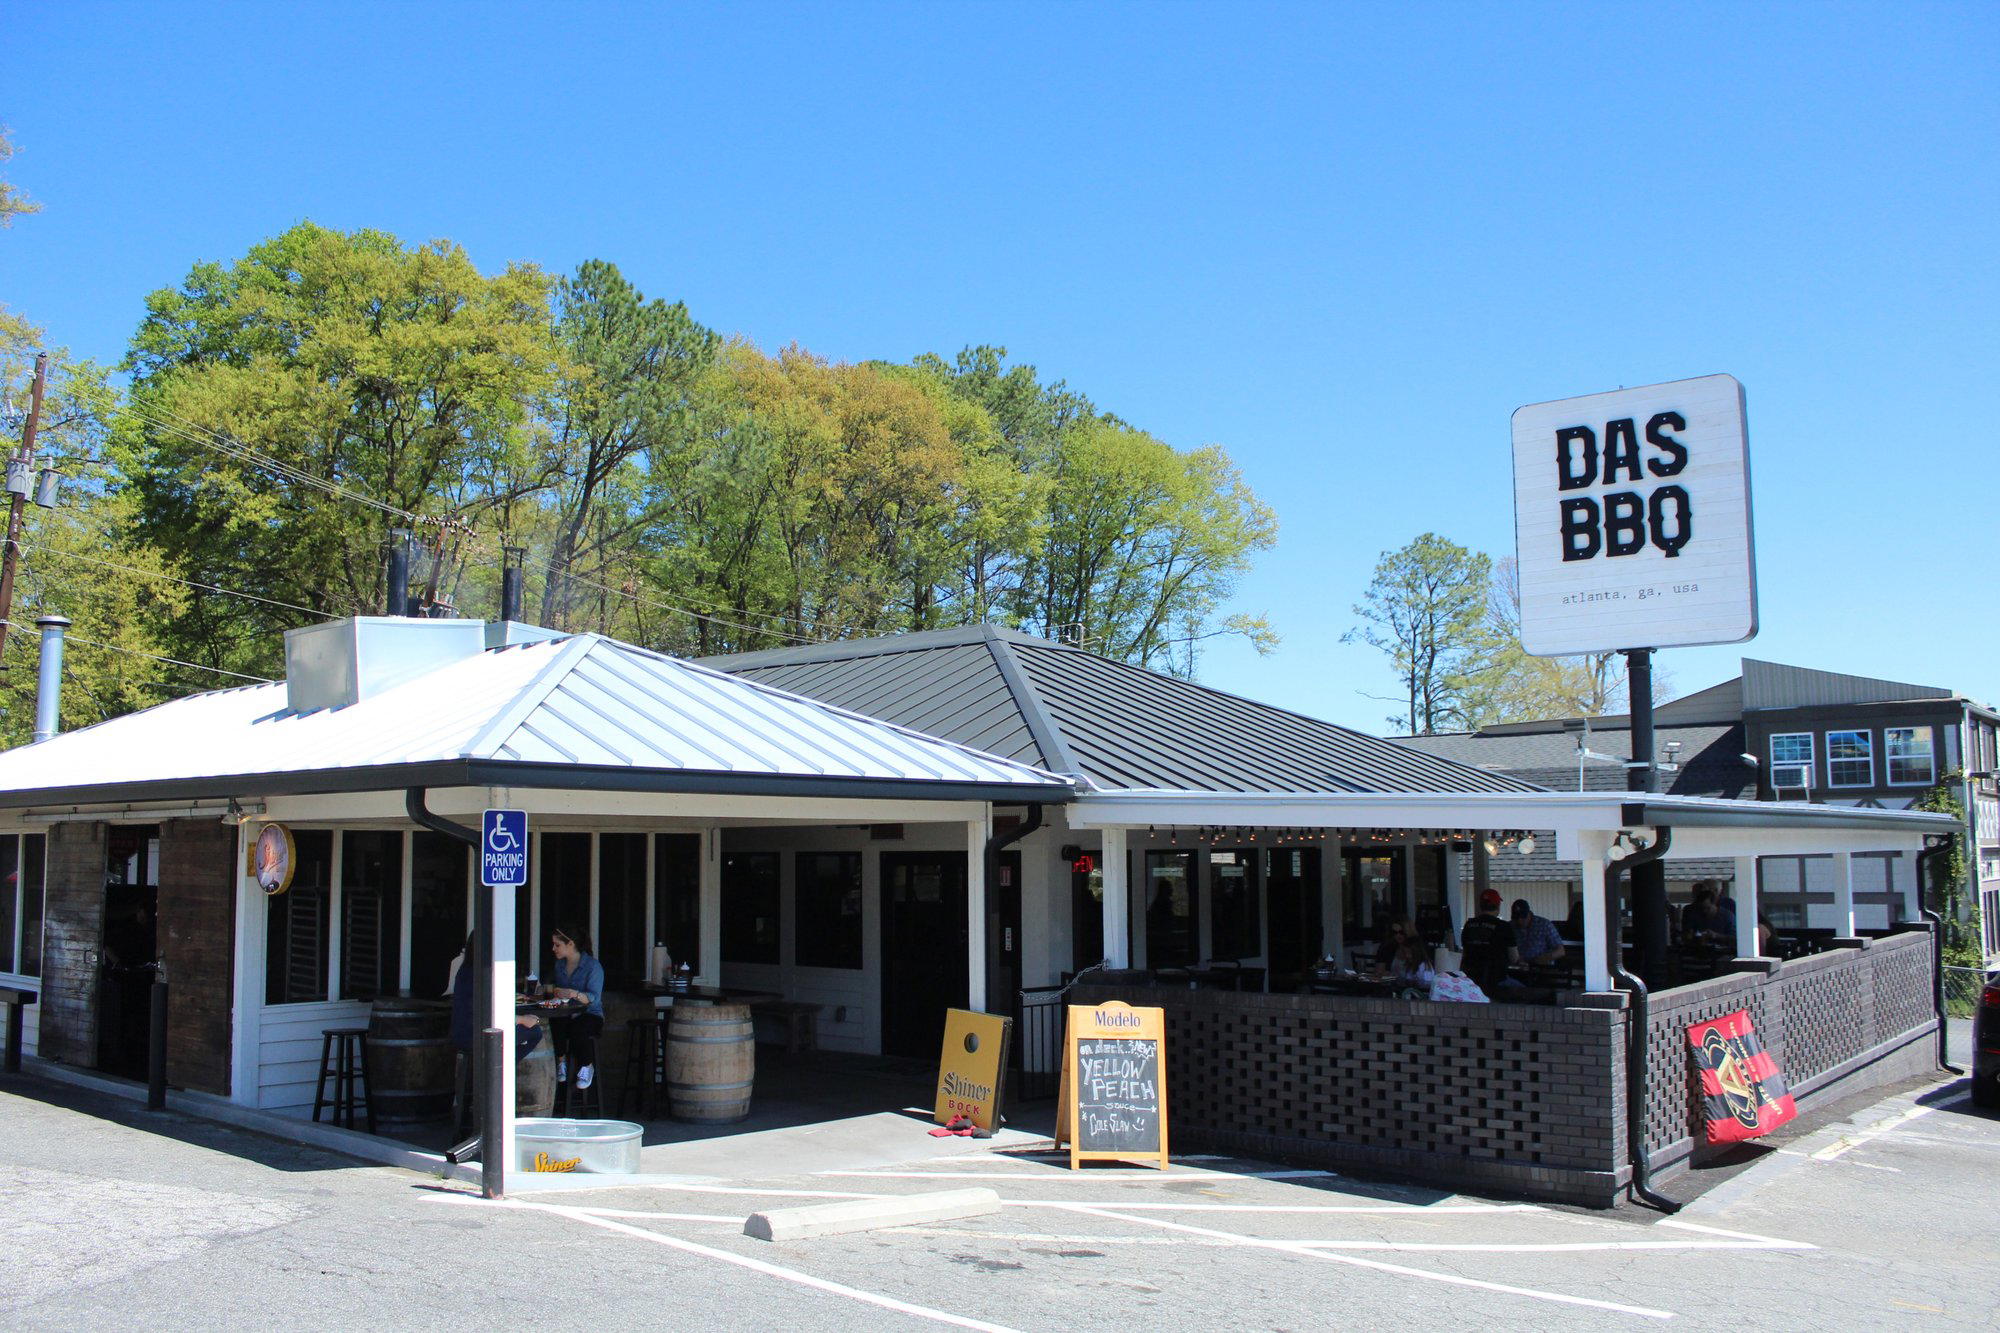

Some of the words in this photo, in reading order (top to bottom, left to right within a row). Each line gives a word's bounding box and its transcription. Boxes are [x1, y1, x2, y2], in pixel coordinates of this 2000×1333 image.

[1556, 411, 1689, 491] DAS
[1560, 485, 1692, 562] BBQ
[1562, 592, 1627, 604] atlanta,
[1638, 588, 1662, 600] ga,
[1673, 583, 1699, 594] usa
[485, 853, 523, 867] PARKING
[491, 867, 516, 881] ONLY
[1095, 1010, 1141, 1028] Modelo
[1081, 1058, 1147, 1085] YELLOW
[941, 1071, 991, 1101] Shiner
[1091, 1078, 1156, 1101] PEACH
[948, 1099, 980, 1115] BOCK
[524, 1152, 582, 1172] Shiner
